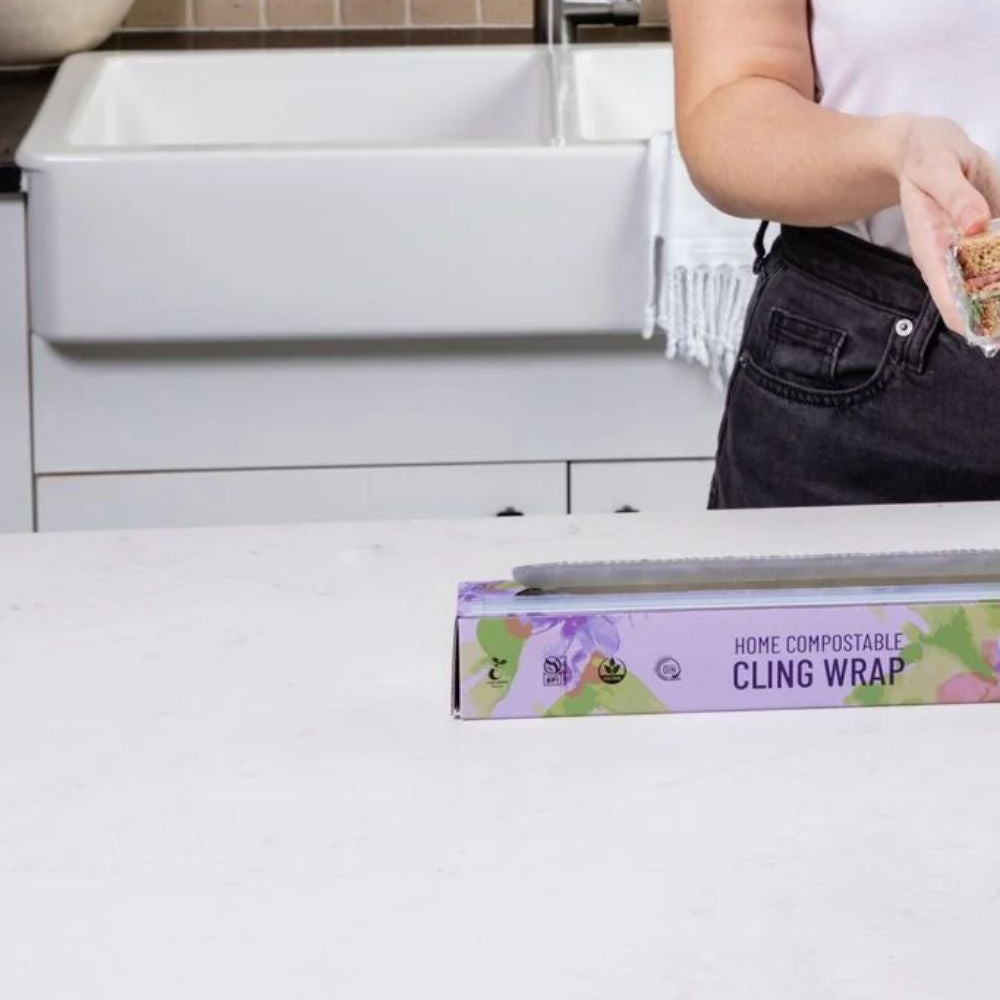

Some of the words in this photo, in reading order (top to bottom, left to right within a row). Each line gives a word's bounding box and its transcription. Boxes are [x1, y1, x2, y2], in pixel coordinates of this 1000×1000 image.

[735, 636, 780, 654] HOME
[786, 633, 904, 653] COMPOSTABLE
[733, 659, 814, 690] CLING
[824, 656, 906, 687] WRAP
